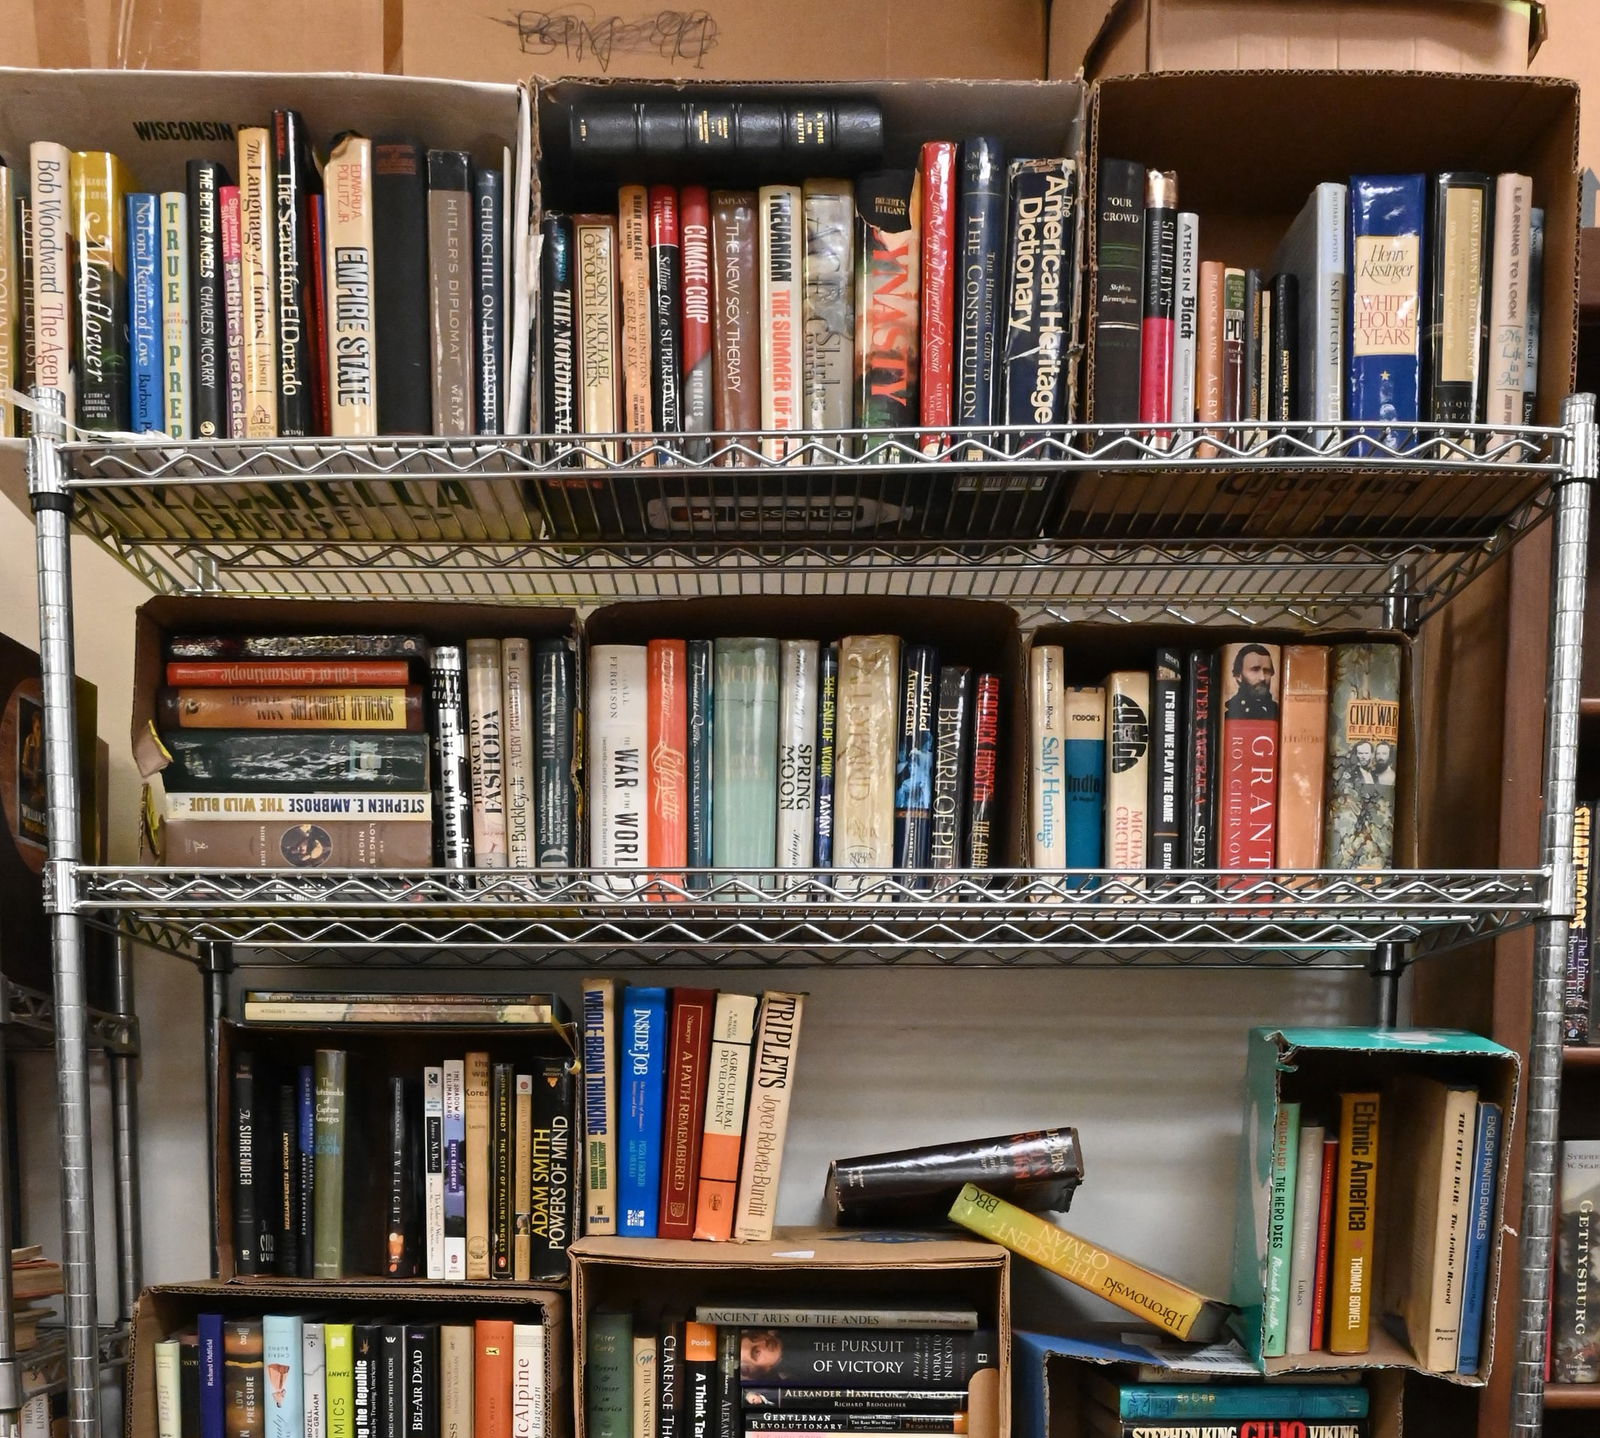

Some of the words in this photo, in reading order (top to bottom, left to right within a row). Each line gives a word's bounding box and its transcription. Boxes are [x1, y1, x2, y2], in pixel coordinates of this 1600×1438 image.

[133, 121, 234, 141] WISCONSIN
[37, 159, 61, 194] Bob
[1062, 196, 1073, 218] The
[37, 199, 64, 294] Woodward
[727, 222, 740, 250] THE
[1042, 174, 1066, 300] American
[1182, 223, 1192, 274] ATHENS
[684, 225, 708, 292] CLIMATE
[727, 253, 740, 292] NEW
[1008, 197, 1043, 332] Dictionary
[335, 247, 370, 332] EMPIRE
[1182, 277, 1190, 291] IN
[40, 303, 64, 336] The
[686, 296, 709, 324] COUP
[727, 296, 740, 325] SEX
[1180, 295, 1196, 339] Black
[1359, 311, 1413, 328] HOUSE
[1361, 295, 1413, 311] WHITE
[1363, 329, 1410, 346] YEARS
[336, 336, 371, 407] STATE
[727, 328, 742, 392] THERAPY
[1034, 304, 1065, 424] Heritage
[1164, 691, 1176, 708] IT'S
[1350, 706, 1374, 725] CIVIL
[1377, 705, 1398, 724] WAR
[1164, 709, 1175, 729] HOW
[1164, 731, 1175, 748] WE
[1164, 750, 1175, 773] PLAY
[1163, 775, 1174, 793] THE
[190, 797, 220, 811] BLUE
[224, 797, 256, 811] WILD
[259, 798, 283, 811] THE
[289, 799, 350, 812] AMBROSE
[357, 800, 364, 812] E.
[368, 799, 424, 813] STEPHEN
[1163, 795, 1174, 823] GAME
[1249, 735, 1274, 869] GRANT
[683, 1051, 693, 1059] A
[757, 998, 796, 1089] TRIPLETS
[682, 1064, 693, 1094] PATH
[714, 1050, 728, 1124] DEVELOPMENT
[723, 1050, 738, 1129] AGRICULTURAL
[552, 1116, 568, 1160] MIND
[1351, 1101, 1376, 1157] Ethnic
[1486, 1116, 1496, 1156] ENGLISH
[239, 1125, 253, 1186] SURRENDER
[533, 1129, 551, 1183] SMITH
[674, 1100, 690, 1192] REMEMBERED
[551, 1163, 567, 1186] OF
[1482, 1159, 1495, 1195] PAINTED
[532, 1185, 549, 1238] ADAM
[1348, 1160, 1374, 1232] America
[549, 1189, 567, 1250] POWERS
[1476, 1196, 1490, 1240] ENAMELS
[993, 1224, 1065, 1266] ASCENT
[1039, 1225, 1085, 1258] MAN
[1065, 1258, 1100, 1286] THE
[1084, 1248, 1109, 1270] OF
[1574, 1199, 1594, 1337] GETTYSBURG
[814, 1342, 836, 1351] THE
[841, 1340, 904, 1352] PURSUIT
[412, 1349, 423, 1396] DEAD
[662, 1335, 676, 1410] CLARENCE
[695, 1373, 706, 1381] A
[814, 1361, 832, 1372] OF
[837, 1361, 904, 1374] VICTORY
[412, 1399, 423, 1431] BEL-AIR
[695, 1384, 706, 1417] Think
